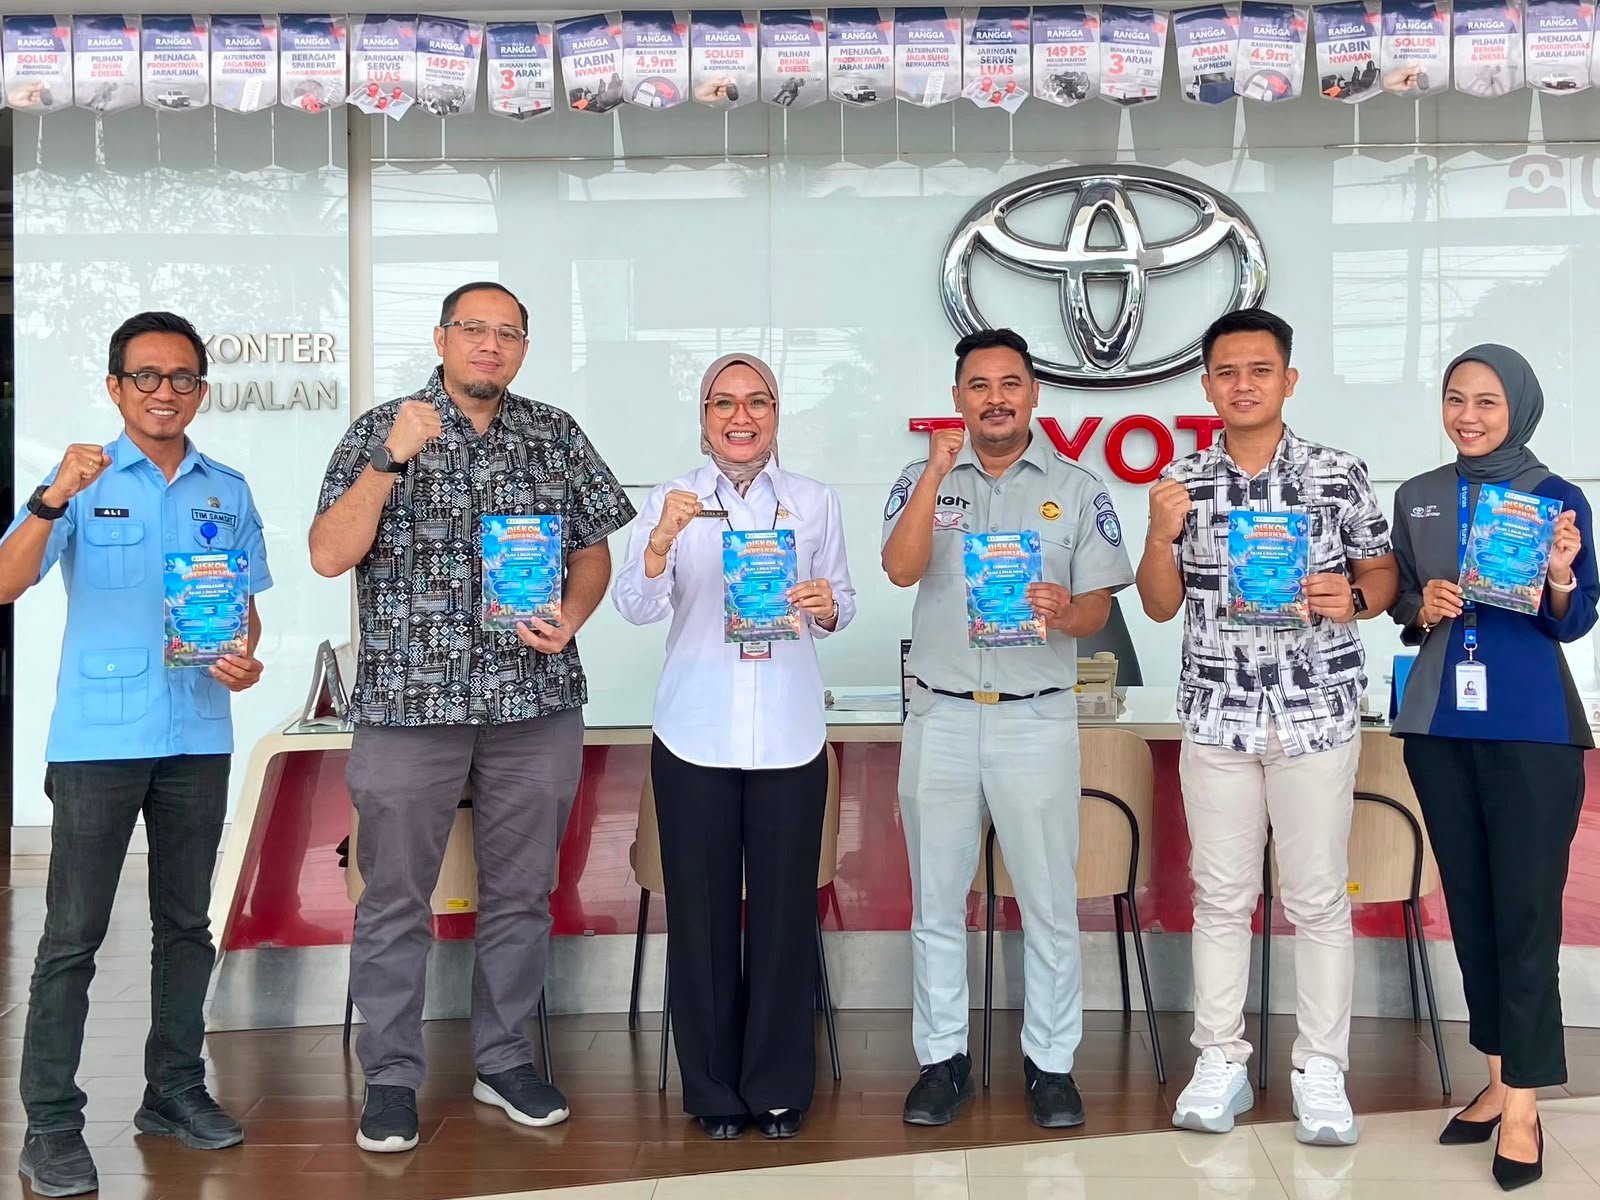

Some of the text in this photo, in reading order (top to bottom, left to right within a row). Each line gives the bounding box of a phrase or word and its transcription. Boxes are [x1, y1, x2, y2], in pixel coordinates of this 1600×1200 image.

[1396, 22, 1433, 30] RANGGA
[1468, 22, 1505, 30] RANGGA
[1540, 19, 1578, 27] RANGGA
[976, 31, 1012, 39] RANGGA
[1047, 30, 1084, 38] RANGGA
[1114, 30, 1150, 40] RANGGA
[1190, 28, 1226, 40] RANGGA
[1254, 27, 1290, 36] RANGGA
[1328, 25, 1366, 36] RANGGA
[17, 39, 55, 47] RANGGA
[88, 38, 124, 47] RANGGA
[225, 38, 261, 46] RANGGA
[572, 38, 608, 50] RANGGA
[1395, 38, 1436, 48] SOLUSI
[1538, 35, 1582, 43] MENJAGA
[429, 40, 464, 52] RANGGA
[500, 46, 536, 54] RANGGA
[1192, 44, 1228, 58] AMAN
[1328, 40, 1370, 55] KABIN
[1530, 42, 1590, 50] PRODUKTIVITAS
[705, 50, 744, 58] SOLUSI
[1046, 46, 1069, 57] 149
[17, 54, 58, 64] SOLUSI
[428, 57, 448, 69] 149
[574, 54, 614, 68] KABIN
[980, 56, 1014, 64] SERVIS
[1198, 55, 1226, 63] DENGAN
[1328, 53, 1371, 64] NYAMAN
[367, 62, 400, 70] SERVIS
[1108, 54, 1152, 74] 3 ARAH
[1209, 60, 1232, 70] MESIN
[575, 65, 616, 78] NYAMAN
[980, 65, 1014, 75] LUAS
[367, 71, 400, 82] LUAS
[500, 70, 514, 89] 3
[1503, 500, 1538, 512] DISKON
[194, 512, 208, 520] TIM
[506, 526, 540, 534] DISKON
[1253, 524, 1288, 532] DISKON
[988, 542, 1020, 552] DISKON
[192, 562, 228, 571] DISKON
